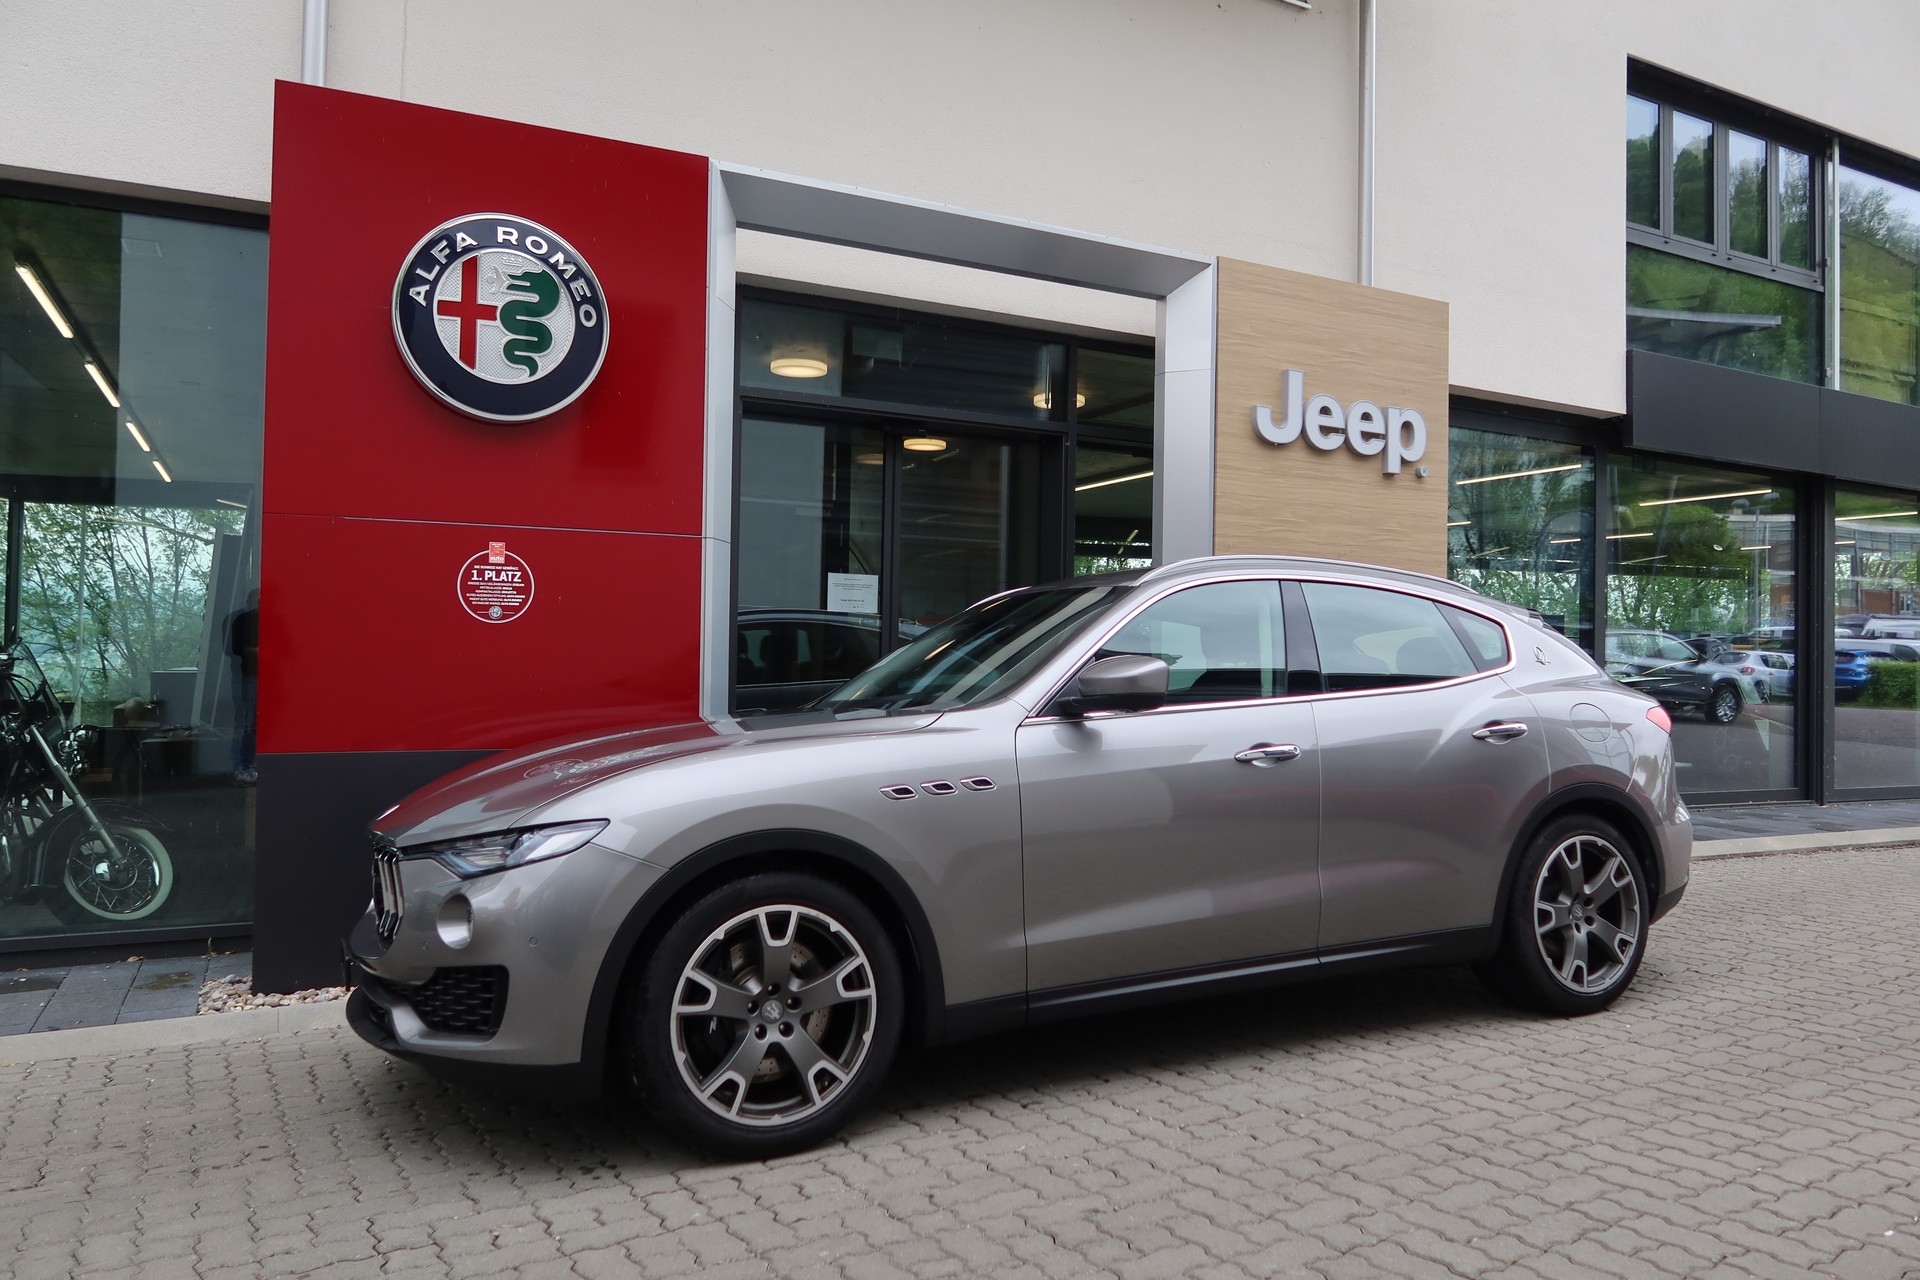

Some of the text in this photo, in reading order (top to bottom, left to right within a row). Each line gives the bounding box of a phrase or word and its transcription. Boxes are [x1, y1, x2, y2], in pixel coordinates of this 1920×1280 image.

[408, 225, 597, 328] ALFA ROMEO
[1251, 367, 1427, 476] Jeep
[471, 570, 522, 582] 1. PLATZ
